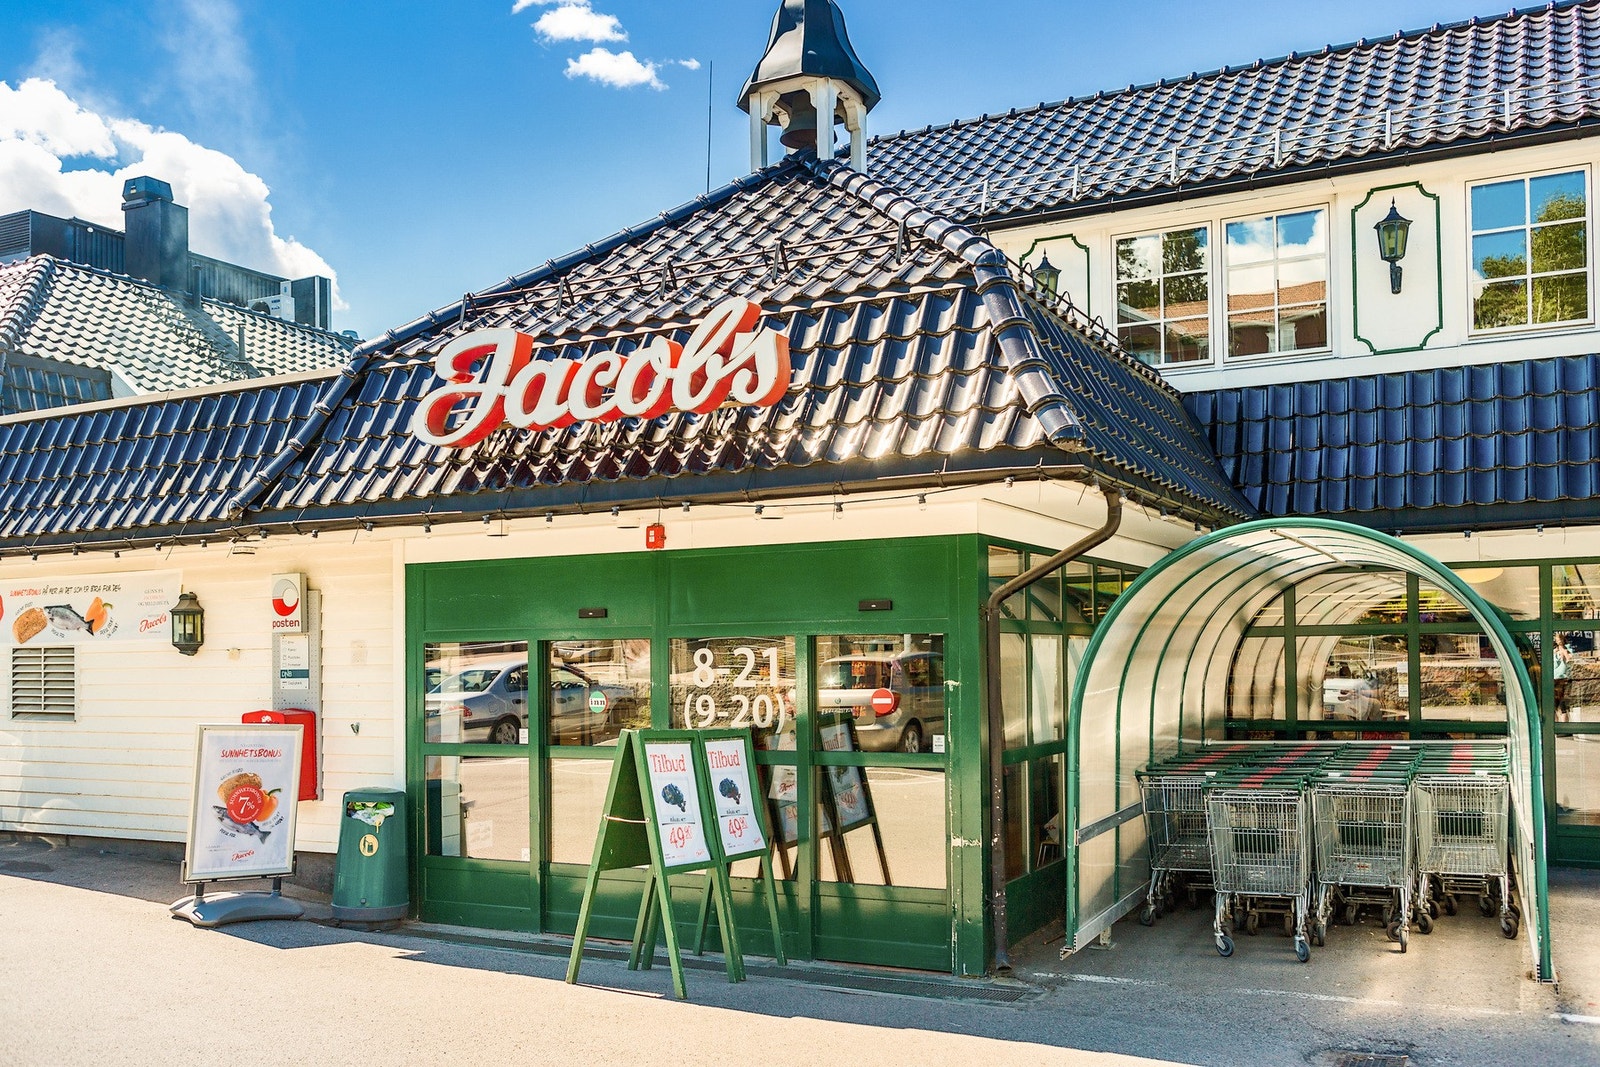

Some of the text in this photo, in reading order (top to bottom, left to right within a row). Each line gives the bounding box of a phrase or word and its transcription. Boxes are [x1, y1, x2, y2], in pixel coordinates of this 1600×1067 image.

[272, 619, 300, 629] posten
[590, 698, 606, 706] inn
[220, 748, 282, 758] SUNNHETSBONUS
[650, 753, 687, 773] Tilbud
[708, 750, 741, 769] Tilbud
